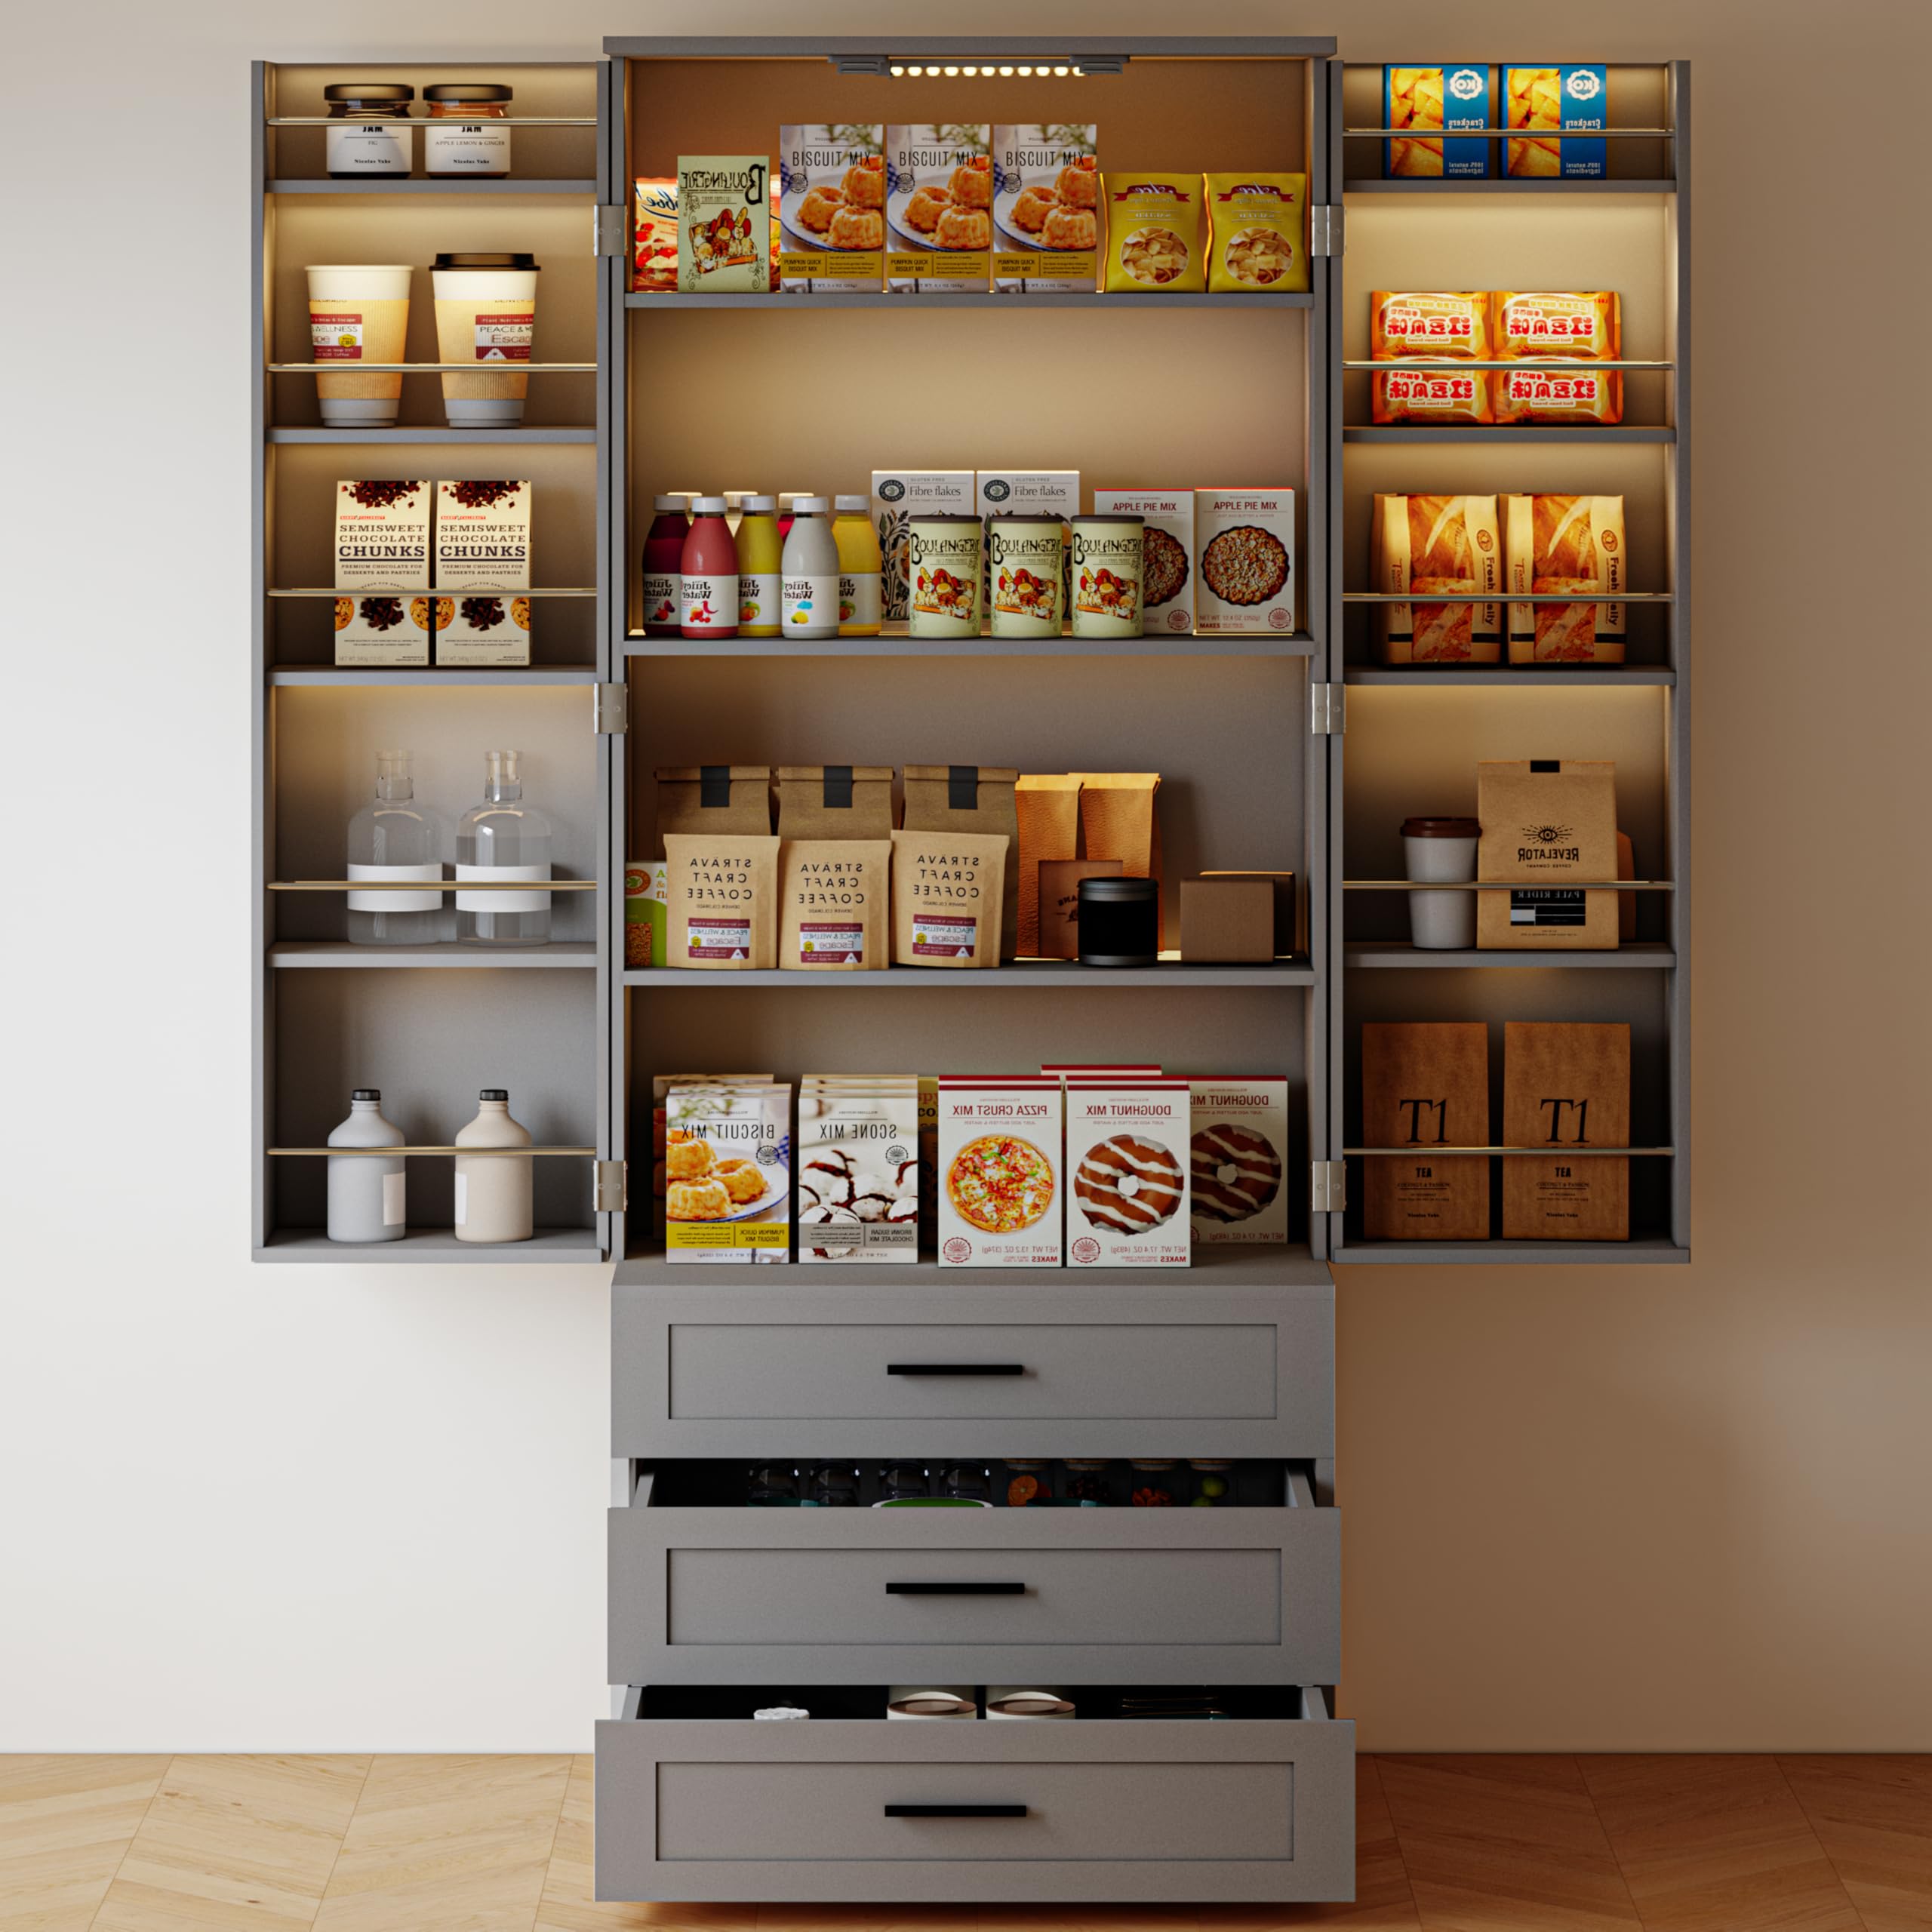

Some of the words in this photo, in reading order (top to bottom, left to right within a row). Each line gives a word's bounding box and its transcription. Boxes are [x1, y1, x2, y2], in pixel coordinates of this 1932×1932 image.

[792, 151, 842, 166] BISCUIT
[850, 151, 871, 166] MIX
[900, 151, 949, 166] BISCUIT
[956, 151, 977, 166] MIX
[1007, 151, 1055, 166] BISCUIT
[1063, 151, 1084, 166] MIX
[910, 486, 931, 496] Fibre
[935, 486, 961, 496] flakes
[1015, 486, 1037, 496] Fibre
[1040, 486, 1066, 496] flakes
[1113, 503, 1141, 511] APPLE
[1143, 503, 1157, 511] PIE
[1160, 503, 1177, 511] MIX
[1214, 502, 1241, 510] APPLE
[1244, 502, 1257, 510] PIE
[1262, 502, 1277, 510] MIX
[339, 546, 425, 557] CHUNKS
[440, 546, 526, 557] CHUNKS
[910, 533, 980, 565] BOULANGERIE
[992, 533, 1061, 565] BOULANGERIE
[1072, 533, 1143, 565] BOULANGERIE
[1486, 557, 1496, 590] Fresh
[1611, 557, 1620, 590] Fresh
[1485, 601, 1495, 626] aily
[1608, 601, 1618, 626] aily
[1399, 1099, 1450, 1143] T1
[1540, 1099, 1589, 1143] T1
[1416, 1168, 1432, 1178] TEA
[1555, 1167, 1571, 1177] TEA
